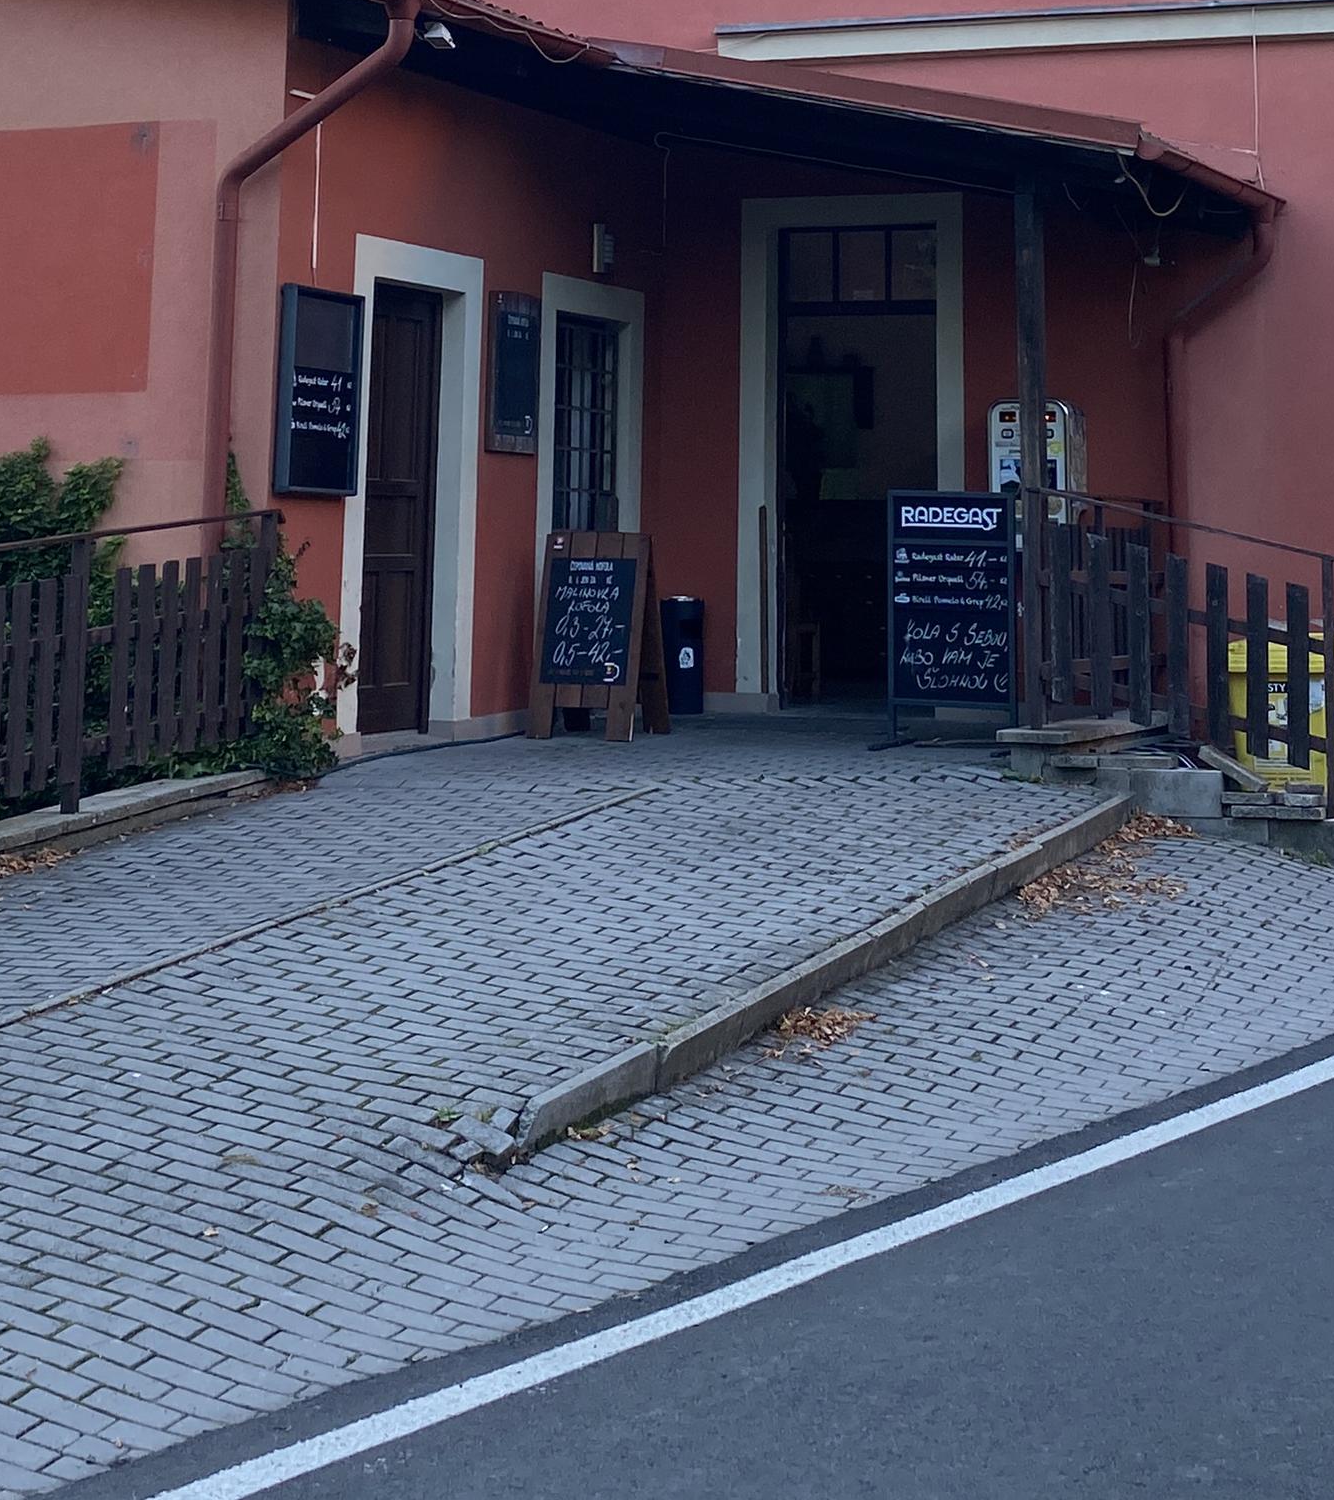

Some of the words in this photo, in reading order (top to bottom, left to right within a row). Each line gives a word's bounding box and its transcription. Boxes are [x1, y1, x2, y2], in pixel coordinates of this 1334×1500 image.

[901, 506, 1002, 530] RADEGAST
[912, 551, 943, 563] Radegast
[912, 573, 936, 582] Pilsner
[938, 575, 963, 586] Urquell
[555, 585, 620, 601] MALINOVKA
[912, 595, 931, 604] Birell
[568, 600, 610, 615] KOFOLA
[905, 619, 940, 640] KOLA
[946, 622, 961, 642] S
[977, 650, 1000, 669] JE
